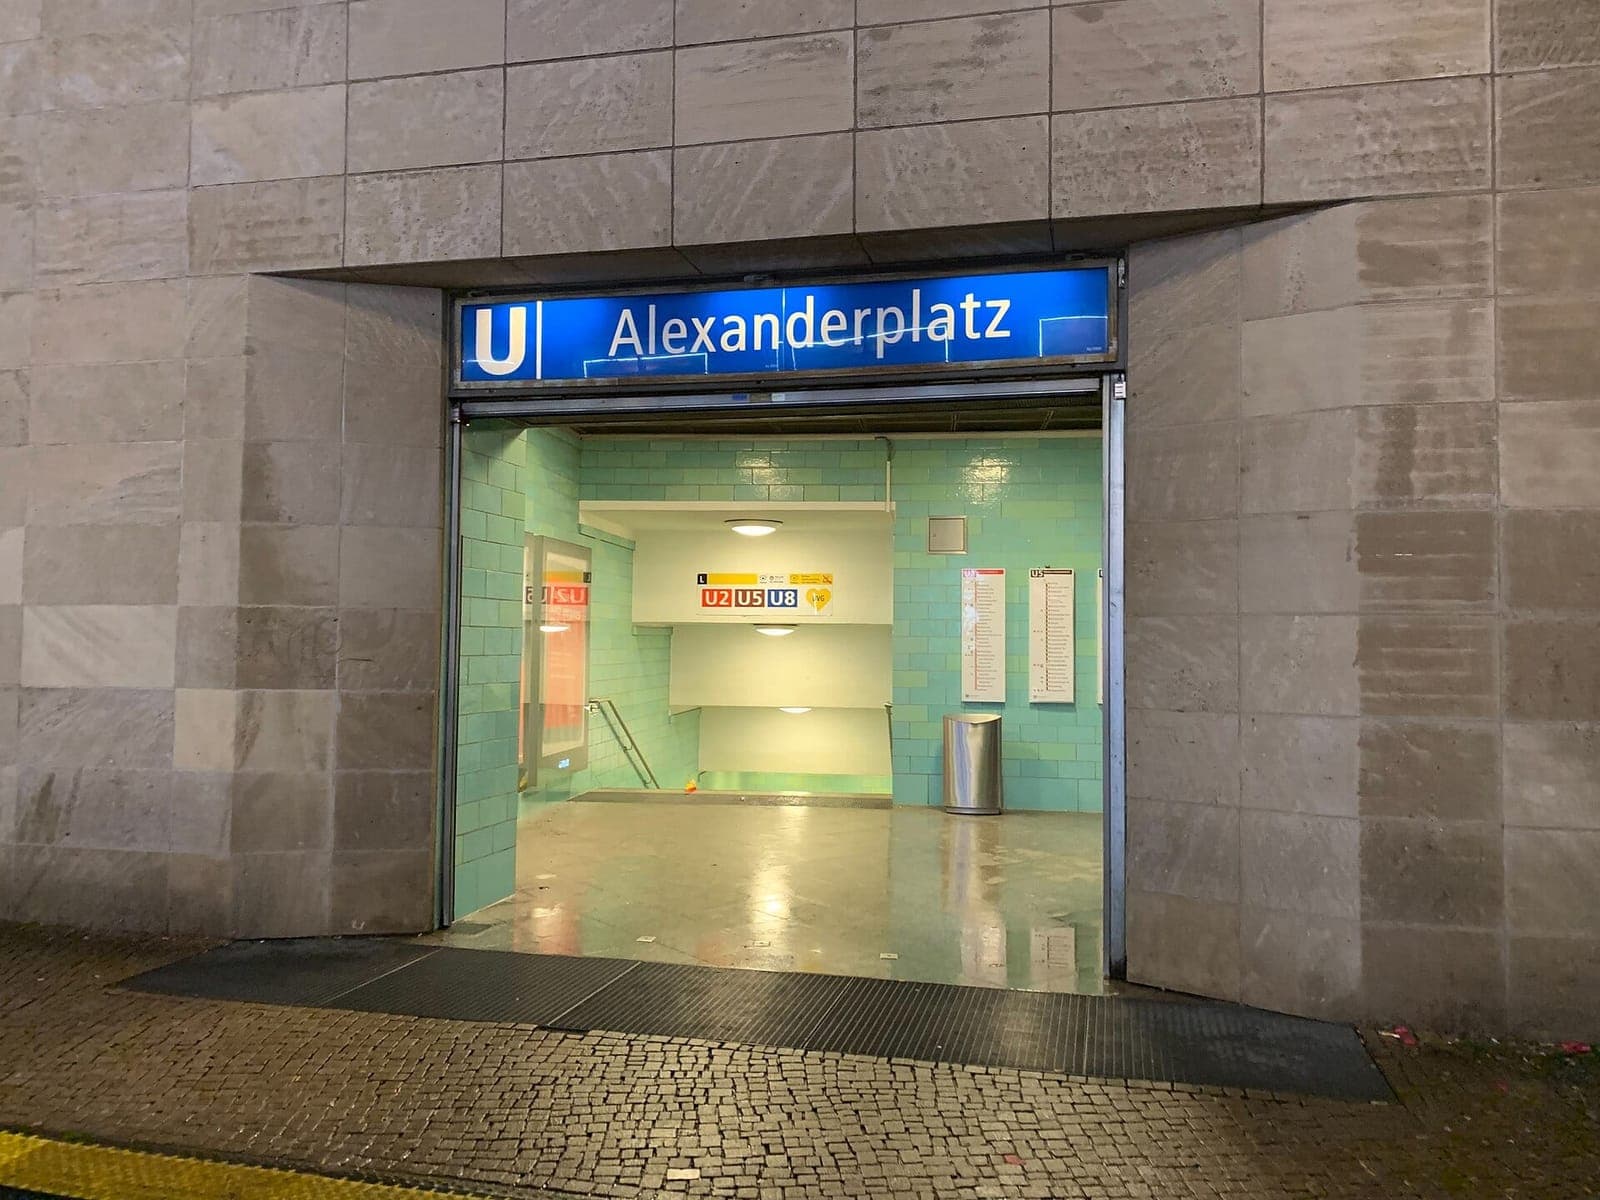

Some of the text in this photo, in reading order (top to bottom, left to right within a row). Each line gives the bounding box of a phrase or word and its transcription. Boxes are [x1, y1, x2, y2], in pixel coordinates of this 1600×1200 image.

[474, 288, 1012, 376] U Alexanderplatz
[699, 575, 705, 583] L
[705, 590, 796, 606] U2 U5 U8
